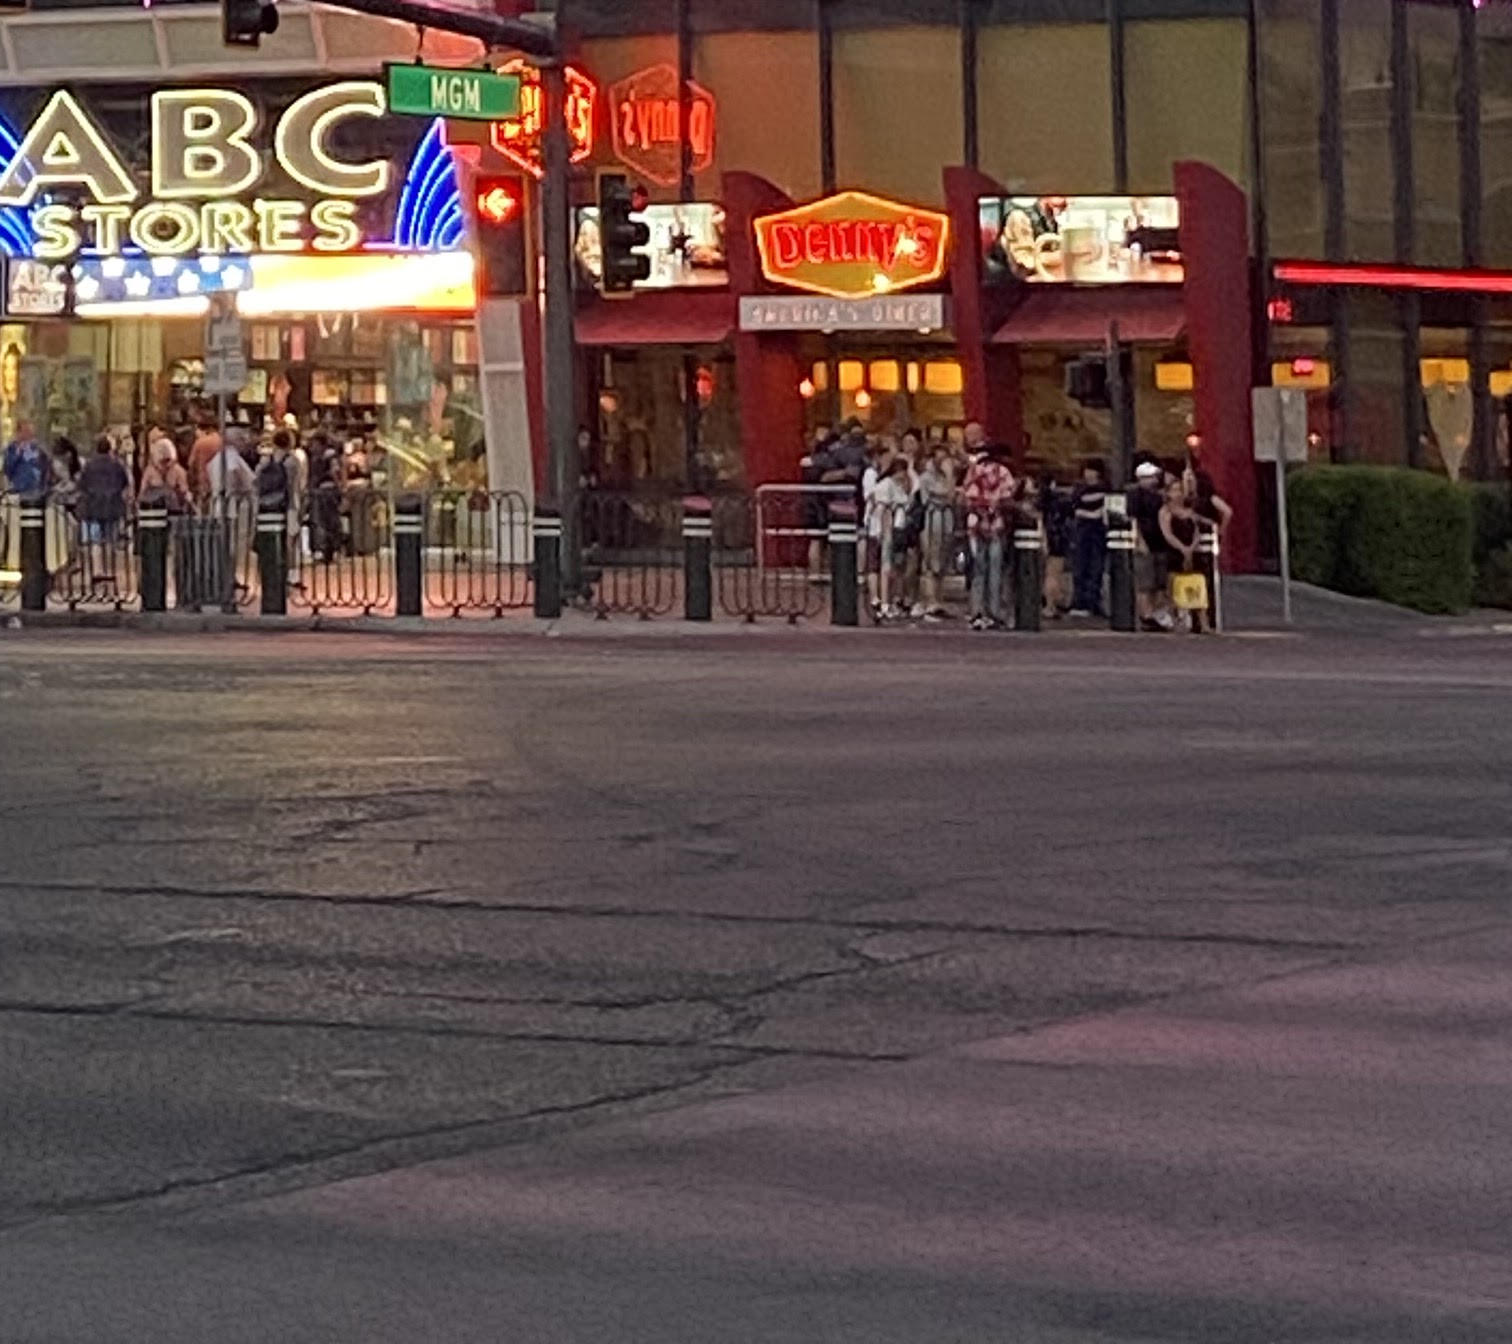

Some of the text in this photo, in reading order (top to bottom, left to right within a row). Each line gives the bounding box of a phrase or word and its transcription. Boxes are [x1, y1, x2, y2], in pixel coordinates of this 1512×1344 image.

[430, 76, 481, 112] MGM
[30, 199, 362, 258] STORES
[771, 215, 935, 273] Denny's
[12, 262, 67, 291] ABC
